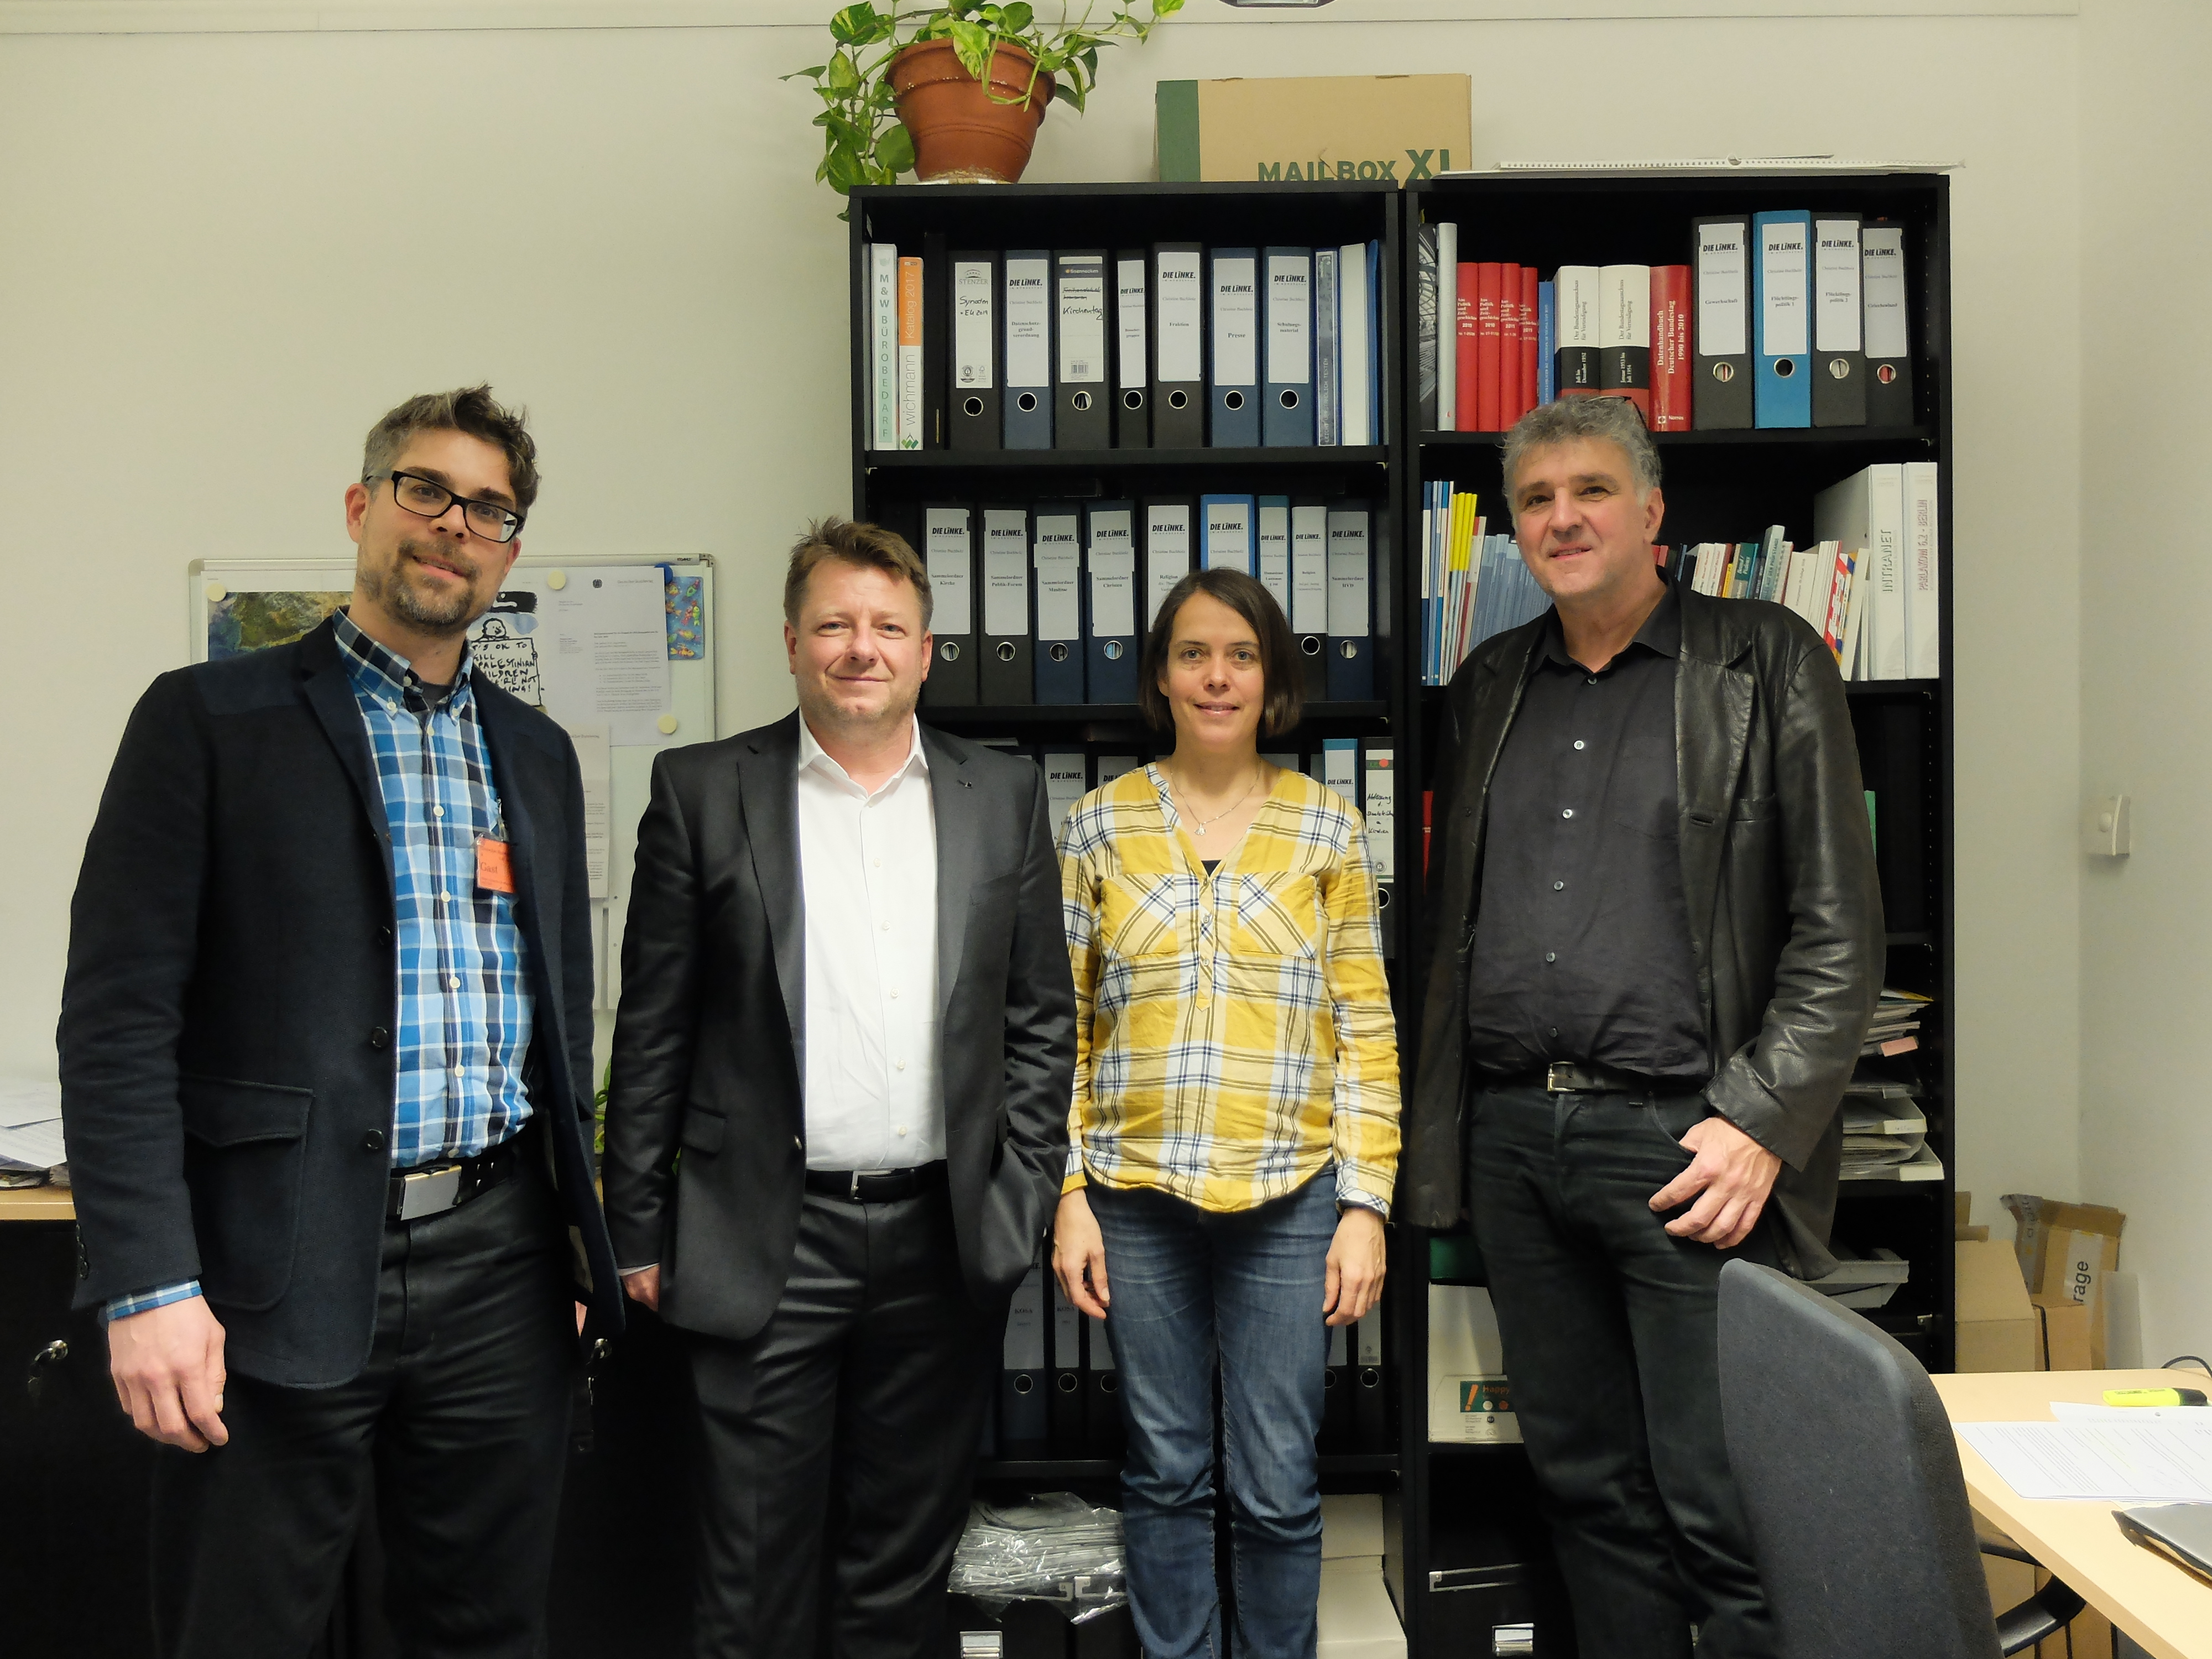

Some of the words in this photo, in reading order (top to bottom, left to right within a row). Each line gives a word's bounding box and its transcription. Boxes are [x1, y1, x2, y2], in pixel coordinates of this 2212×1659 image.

[1258, 160, 1397, 181] MAILBOX
[905, 272, 915, 298] 2017
[959, 296, 989, 307] Synoden
[1063, 305, 1103, 320] Kirchentag
[905, 301, 917, 338] Katalog
[1667, 300, 1676, 337] Bundestag
[902, 354, 916, 426] wichmann
[1917, 499, 1928, 526] BERLIN
[1881, 530, 1893, 592] INTRANET
[1917, 549, 1929, 591] PARLAKOM
[486, 668, 528, 679] ILDREN
[481, 862, 498, 873] Gast
[1483, 1385, 1510, 1395] Happy
